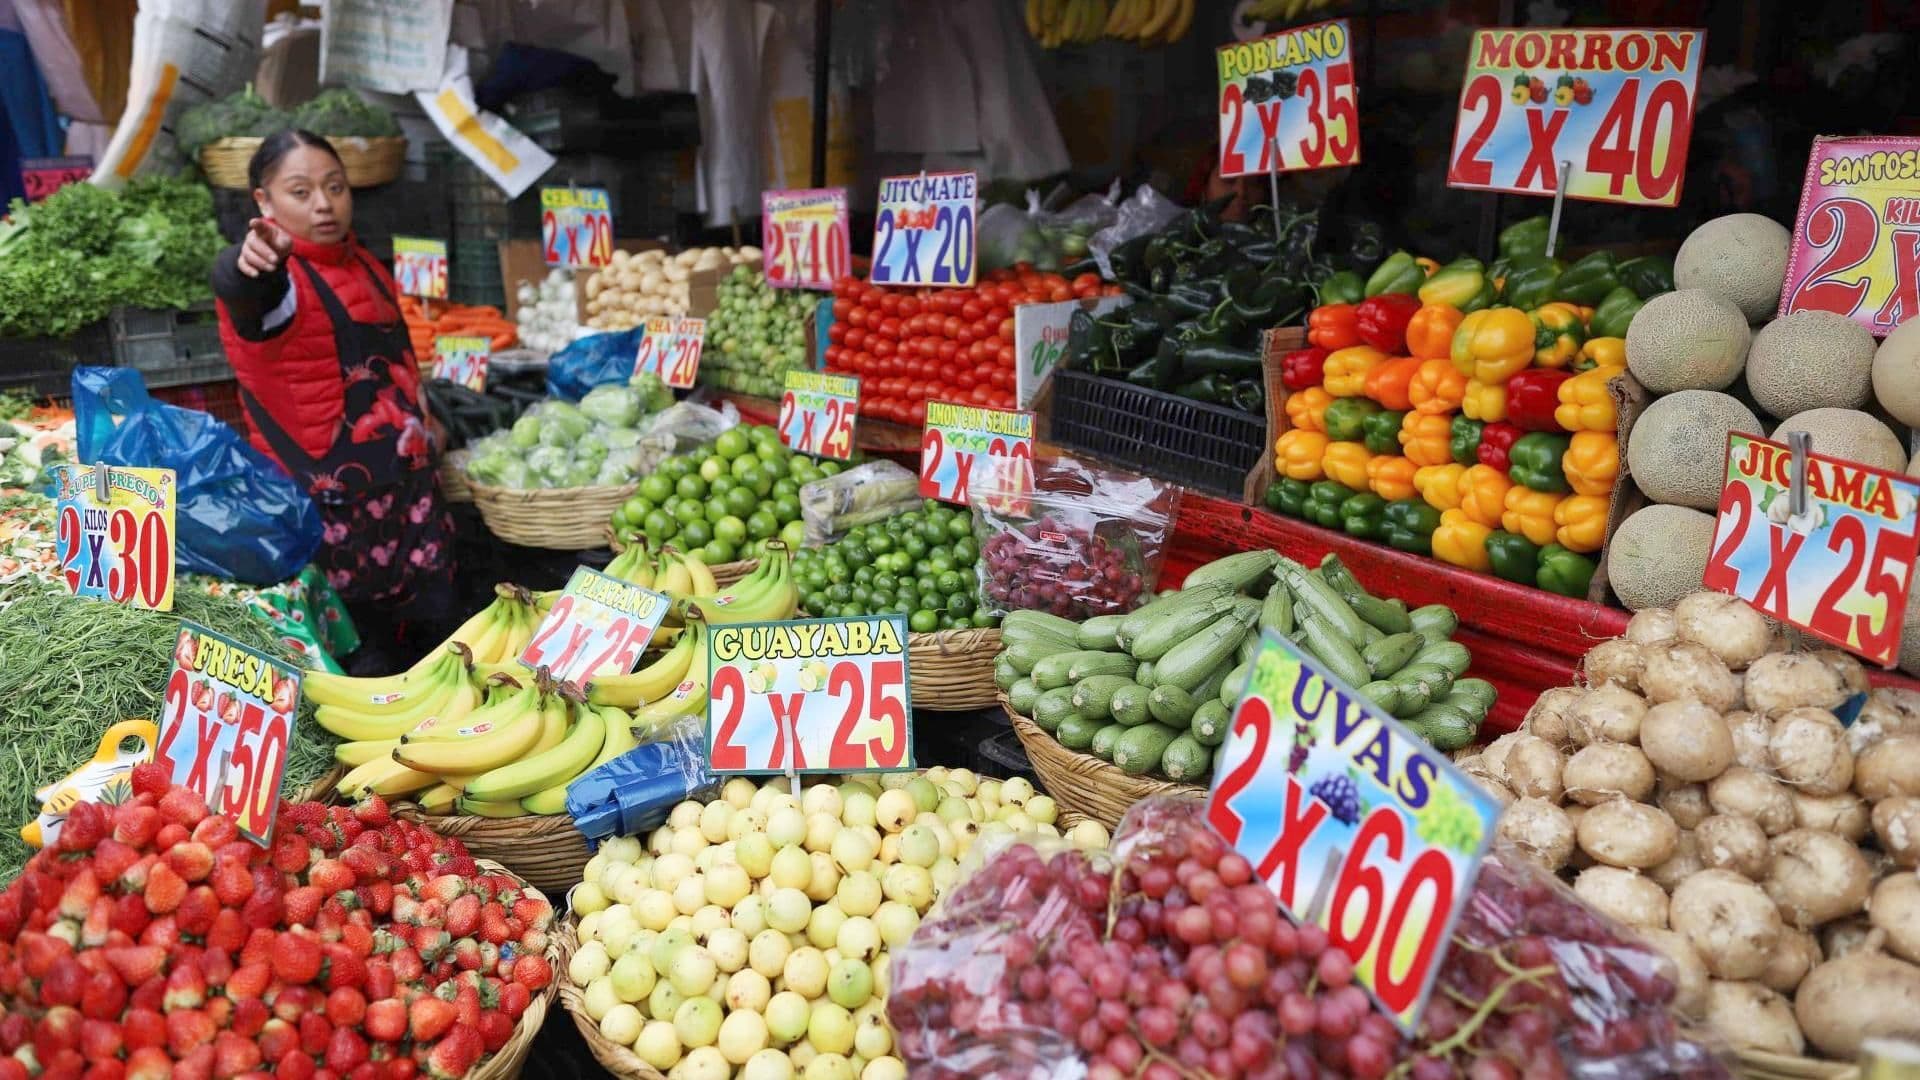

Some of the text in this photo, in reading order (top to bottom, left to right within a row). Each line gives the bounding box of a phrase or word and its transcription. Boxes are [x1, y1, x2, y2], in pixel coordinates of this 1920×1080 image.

[1221, 23, 1346, 80] POBLANO
[1476, 32, 1695, 72] MORRON
[1222, 83, 1245, 174] 2
[1297, 63, 1358, 168] 35
[1452, 75, 1503, 185] 2
[1586, 77, 1690, 200] 40
[543, 211, 560, 262] 2
[583, 212, 614, 266] 20
[768, 223, 785, 280] 2
[802, 221, 845, 282] 40
[873, 208, 895, 282] 2
[933, 205, 974, 284] 20
[1789, 198, 1880, 317] 2
[427, 256, 449, 299] 15
[634, 336, 653, 376] 2
[669, 338, 699, 385] 20
[645, 319, 704, 335] CHAOTE
[464, 352, 488, 393] 25
[779, 391, 795, 447] 2
[821, 398, 856, 459] 25
[927, 402, 958, 428] LIMON
[69, 471, 159, 504] SUPE PRECIO
[919, 428, 943, 499] 2
[84, 509, 108, 531] KILOS
[60, 506, 81, 595] 2
[108, 509, 169, 608] 30
[1703, 480, 1752, 595] 2
[1808, 514, 1916, 656] 25
[576, 573, 658, 619] PLATANO
[193, 634, 275, 704] FRESA
[522, 595, 576, 665] 2
[576, 617, 651, 691] 25
[714, 619, 903, 661] GUAYABA
[711, 665, 747, 770] 2
[828, 660, 907, 769] 25
[1291, 663, 1439, 809] UVAS
[156, 668, 189, 781] 2
[223, 702, 288, 838] 50
[1207, 696, 1272, 848] 2
[1328, 805, 1454, 1014] 60
